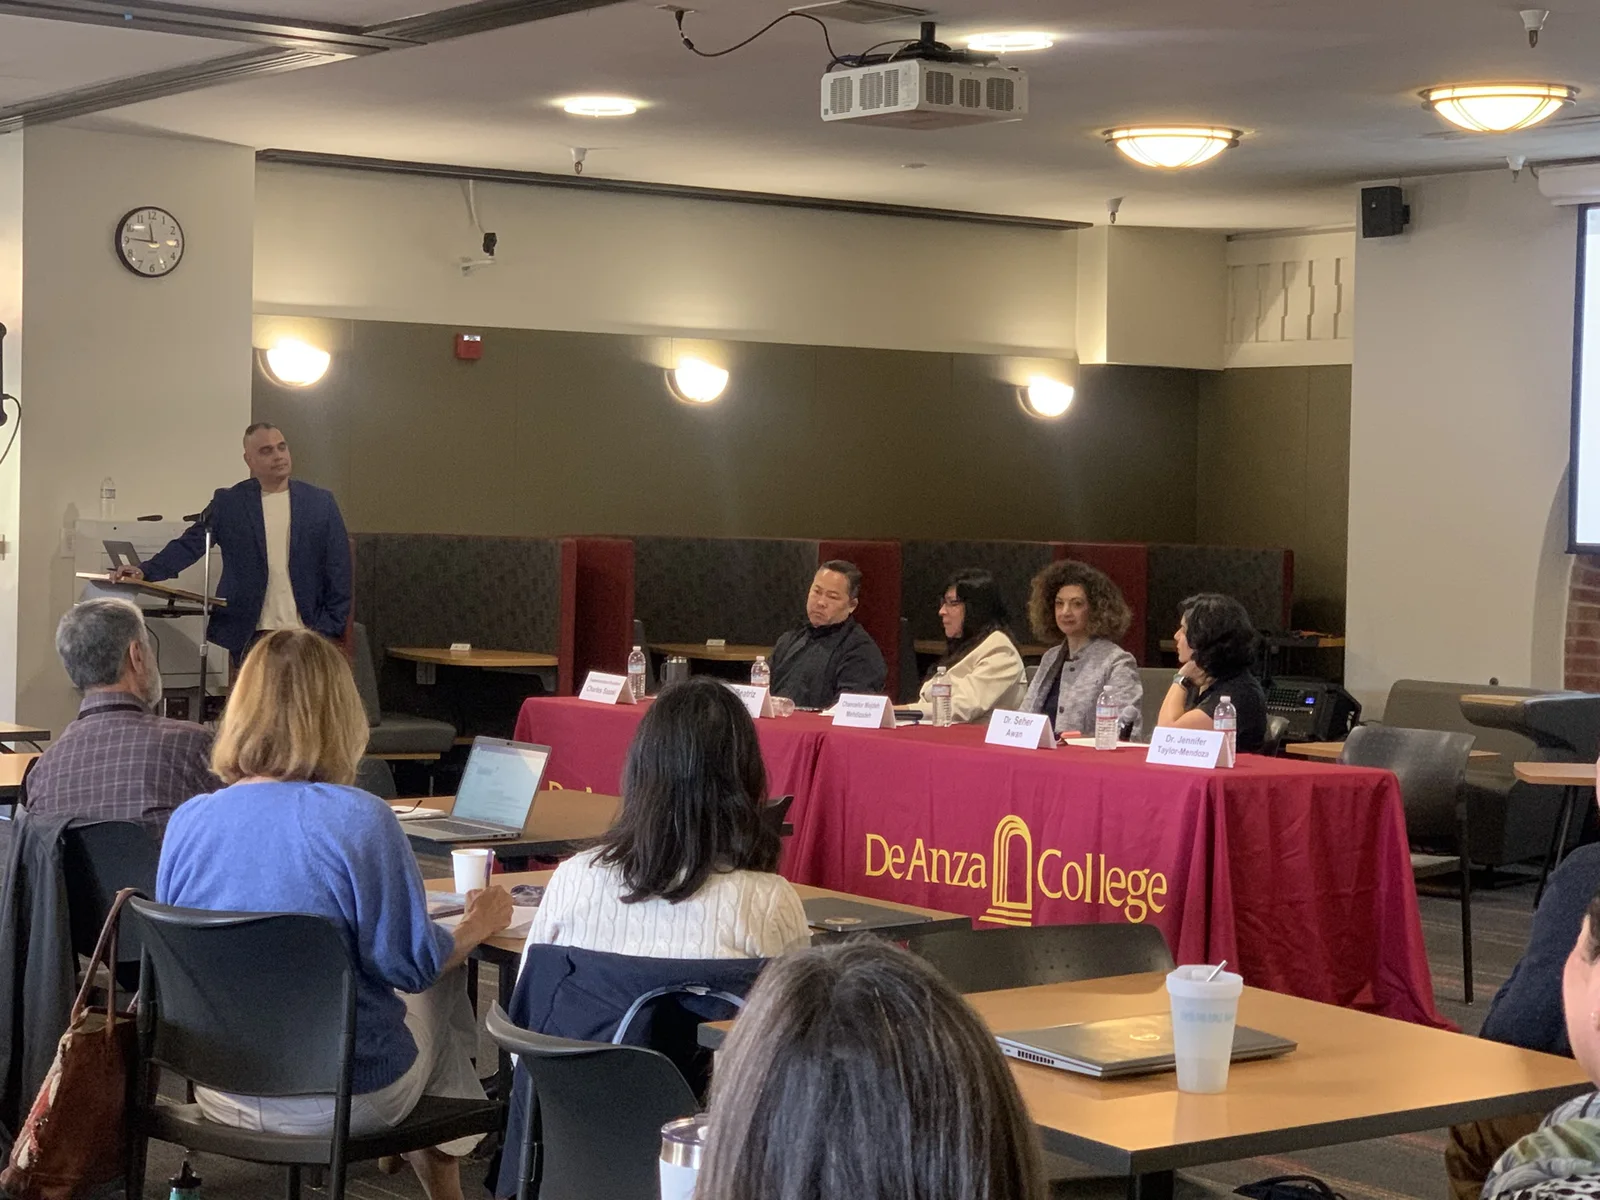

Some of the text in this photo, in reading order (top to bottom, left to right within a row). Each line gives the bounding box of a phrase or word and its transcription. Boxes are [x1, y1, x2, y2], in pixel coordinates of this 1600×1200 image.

[136, 214, 144, 224] 11
[147, 211, 157, 221] 12
[162, 215, 166, 225] 1
[170, 226, 176, 235] 2
[124, 235, 130, 245] 9
[127, 249, 133, 258] 8
[170, 252, 176, 261] 4
[137, 260, 143, 269] 7
[149, 264, 155, 273] 6
[1003, 715, 1034, 726] Dr. Seher
[1005, 729, 1023, 738] Awan
[1165, 734, 1207, 746] Dr. Jennifer
[1157, 745, 1210, 758] Taylor-Mendoza
[1037, 848, 1168, 924] College
